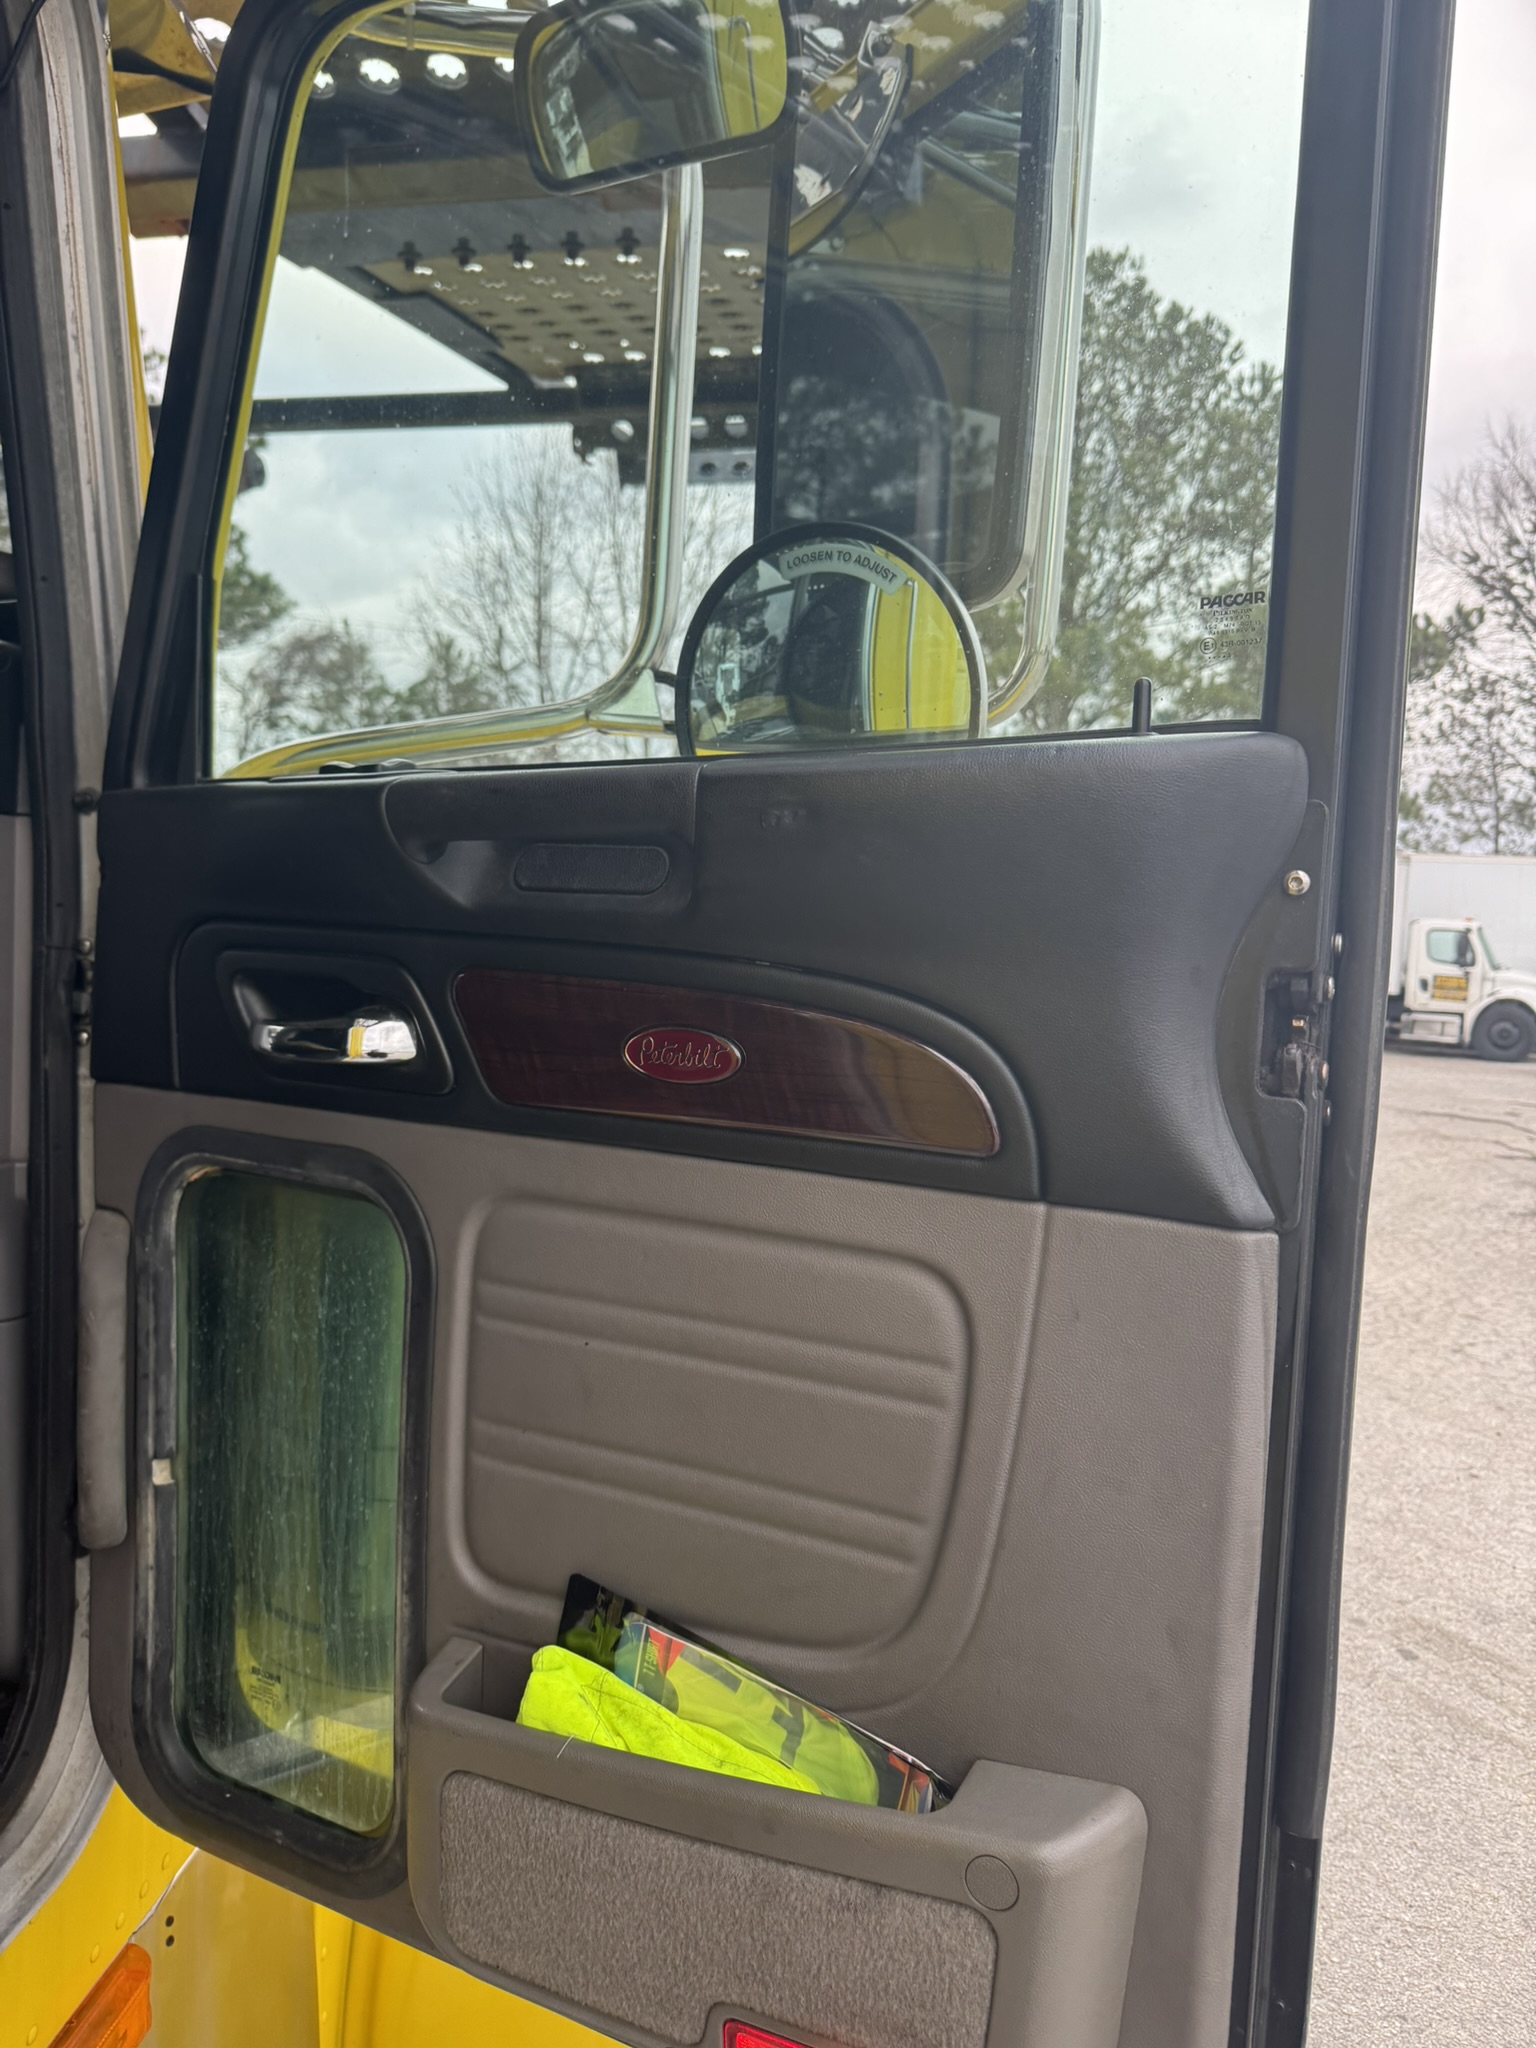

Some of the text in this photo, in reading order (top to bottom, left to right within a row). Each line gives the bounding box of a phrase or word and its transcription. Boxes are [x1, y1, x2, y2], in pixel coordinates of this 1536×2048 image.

[786, 550, 897, 584] LOOSEN TO ADJUST
[1200, 591, 1266, 609] PACCAR
[640, 1036, 730, 1069] Peterbilt
